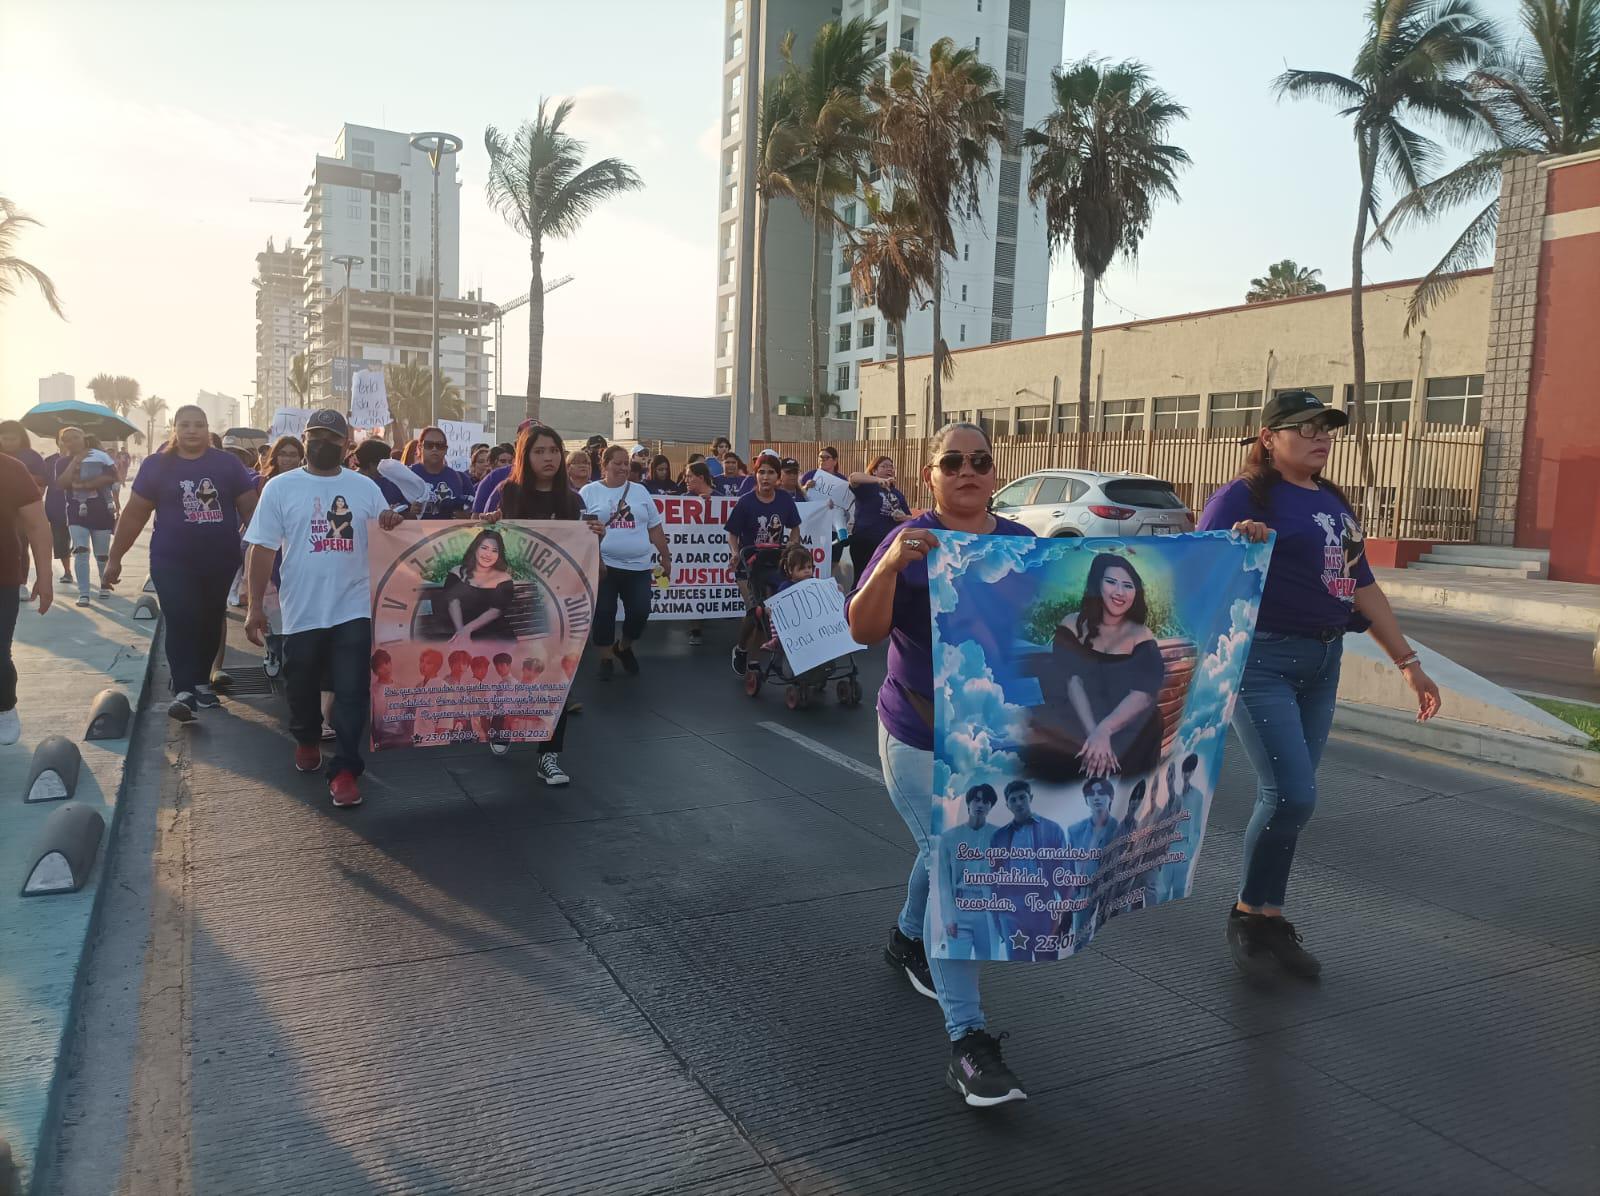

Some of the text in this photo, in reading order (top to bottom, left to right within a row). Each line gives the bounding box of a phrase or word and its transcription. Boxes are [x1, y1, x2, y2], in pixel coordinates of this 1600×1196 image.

[674, 533, 688, 545] DE
[691, 533, 705, 545] LA
[516, 536, 563, 579] SUGA
[675, 552, 684, 564] A
[686, 552, 711, 564] DAR
[664, 588, 706, 600] JUECES
[709, 588, 722, 599] LE
[696, 602, 719, 614] QUE
[956, 842, 984, 860] Los
[985, 847, 1009, 868] que
[1010, 847, 1036, 860] son
[1036, 842, 1089, 861] amados
[963, 867, 1049, 888] inmortalidad,
[955, 893, 1017, 913] recordar,
[1025, 892, 1046, 913] Te
